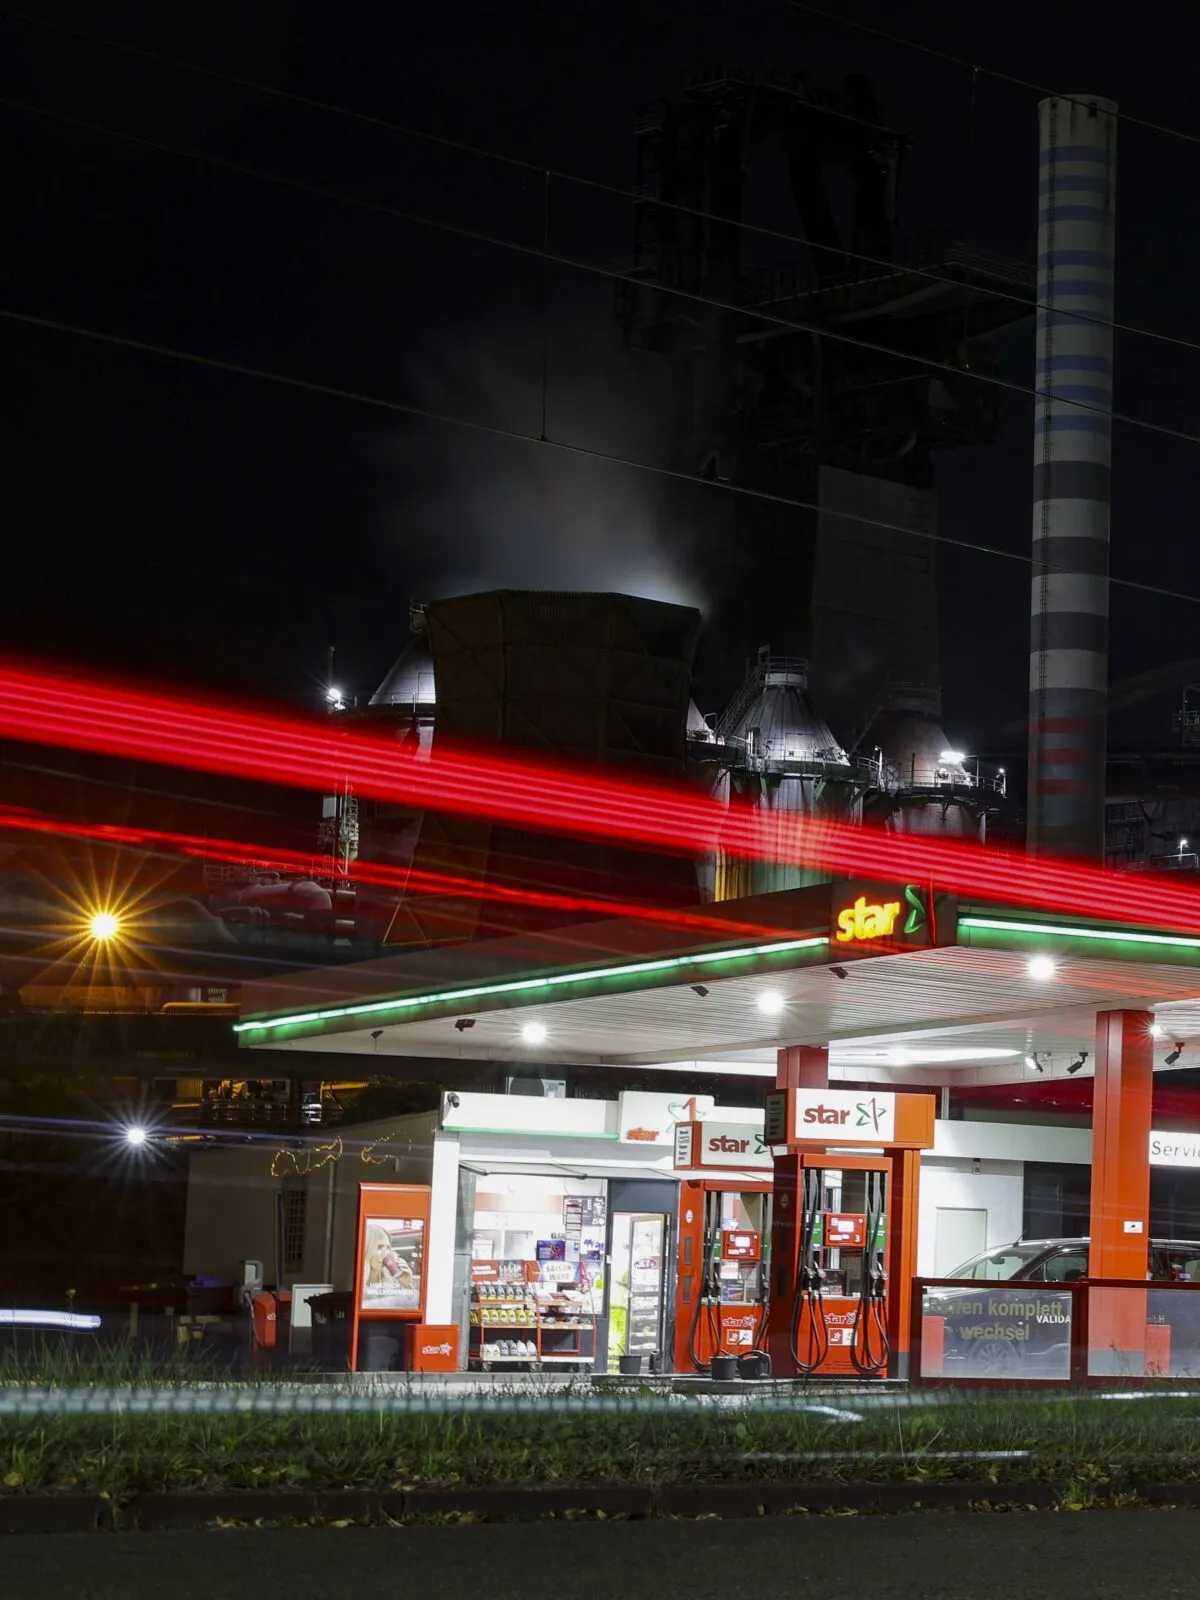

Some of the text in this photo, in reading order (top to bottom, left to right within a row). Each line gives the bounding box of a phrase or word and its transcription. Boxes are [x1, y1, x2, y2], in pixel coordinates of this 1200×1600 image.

[836, 896, 900, 942] star
[803, 1104, 851, 1125] star
[708, 1134, 750, 1154] star
[855, 1234, 860, 1242] 3
[722, 1317, 744, 1327] star
[824, 1312, 847, 1324] star
[1036, 1315, 1071, 1324] VALIDA
[959, 1324, 1030, 1341] wechsel
[422, 1344, 440, 1355] star
